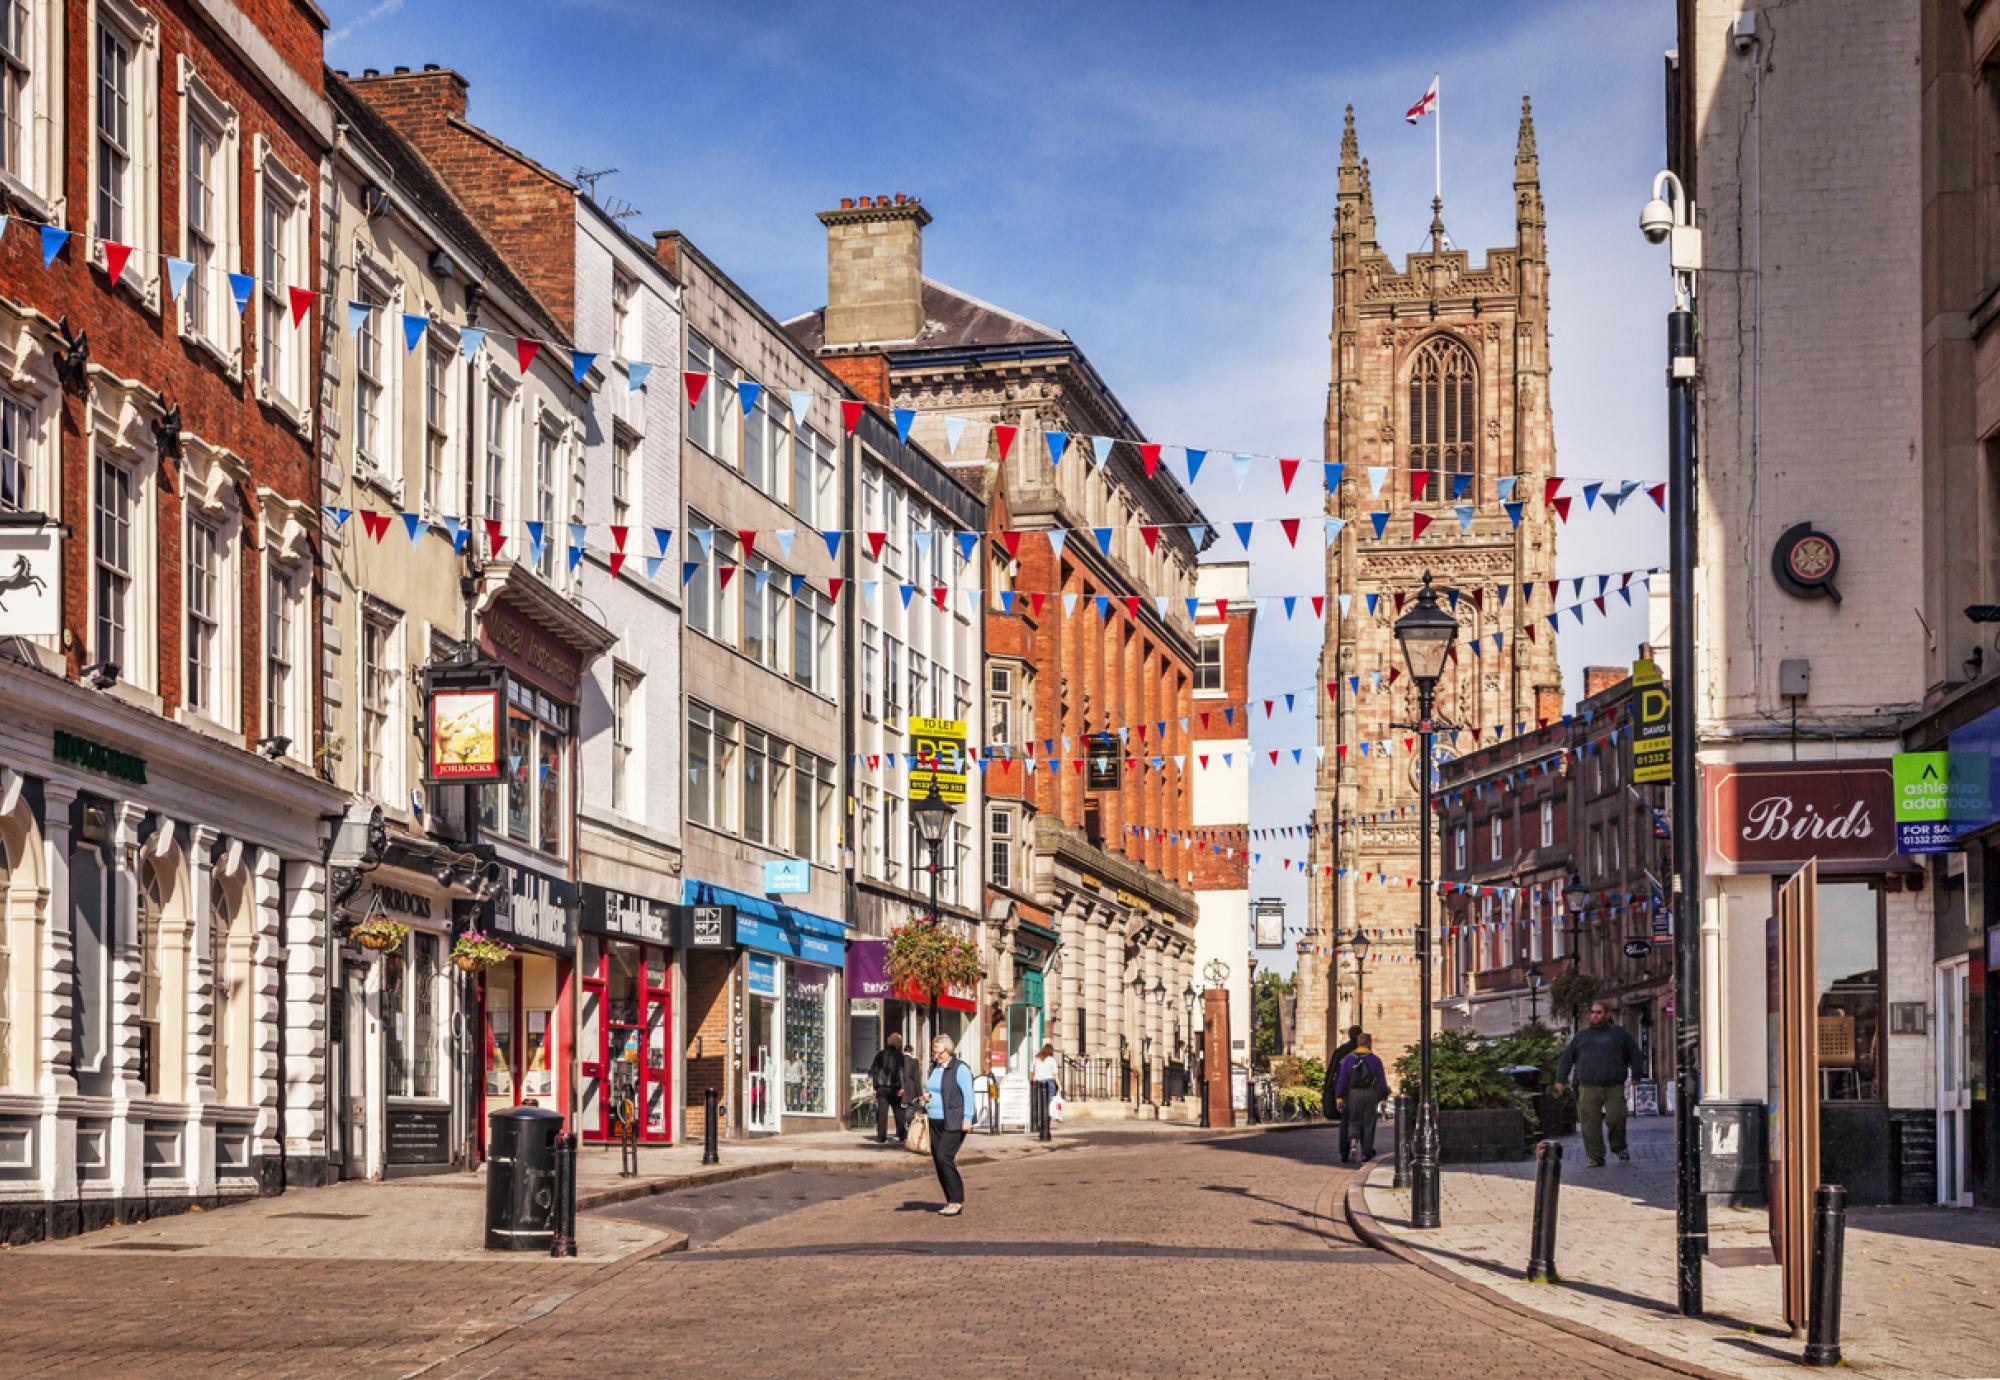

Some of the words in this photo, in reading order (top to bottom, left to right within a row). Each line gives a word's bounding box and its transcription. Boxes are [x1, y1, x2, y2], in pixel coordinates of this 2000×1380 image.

[923, 719, 936, 729] TO
[938, 720, 955, 730] LET
[1643, 724, 1666, 736] DAVID
[1636, 753, 1665, 765] 01332
[438, 764, 492, 775] JORROCKS
[1904, 781, 1949, 795] ashle
[1902, 797, 1949, 810] adam
[1742, 795, 1874, 841] Birds
[1903, 825, 1930, 835] FOR
[1933, 824, 1951, 834] SA
[1904, 836, 1930, 845] 01332
